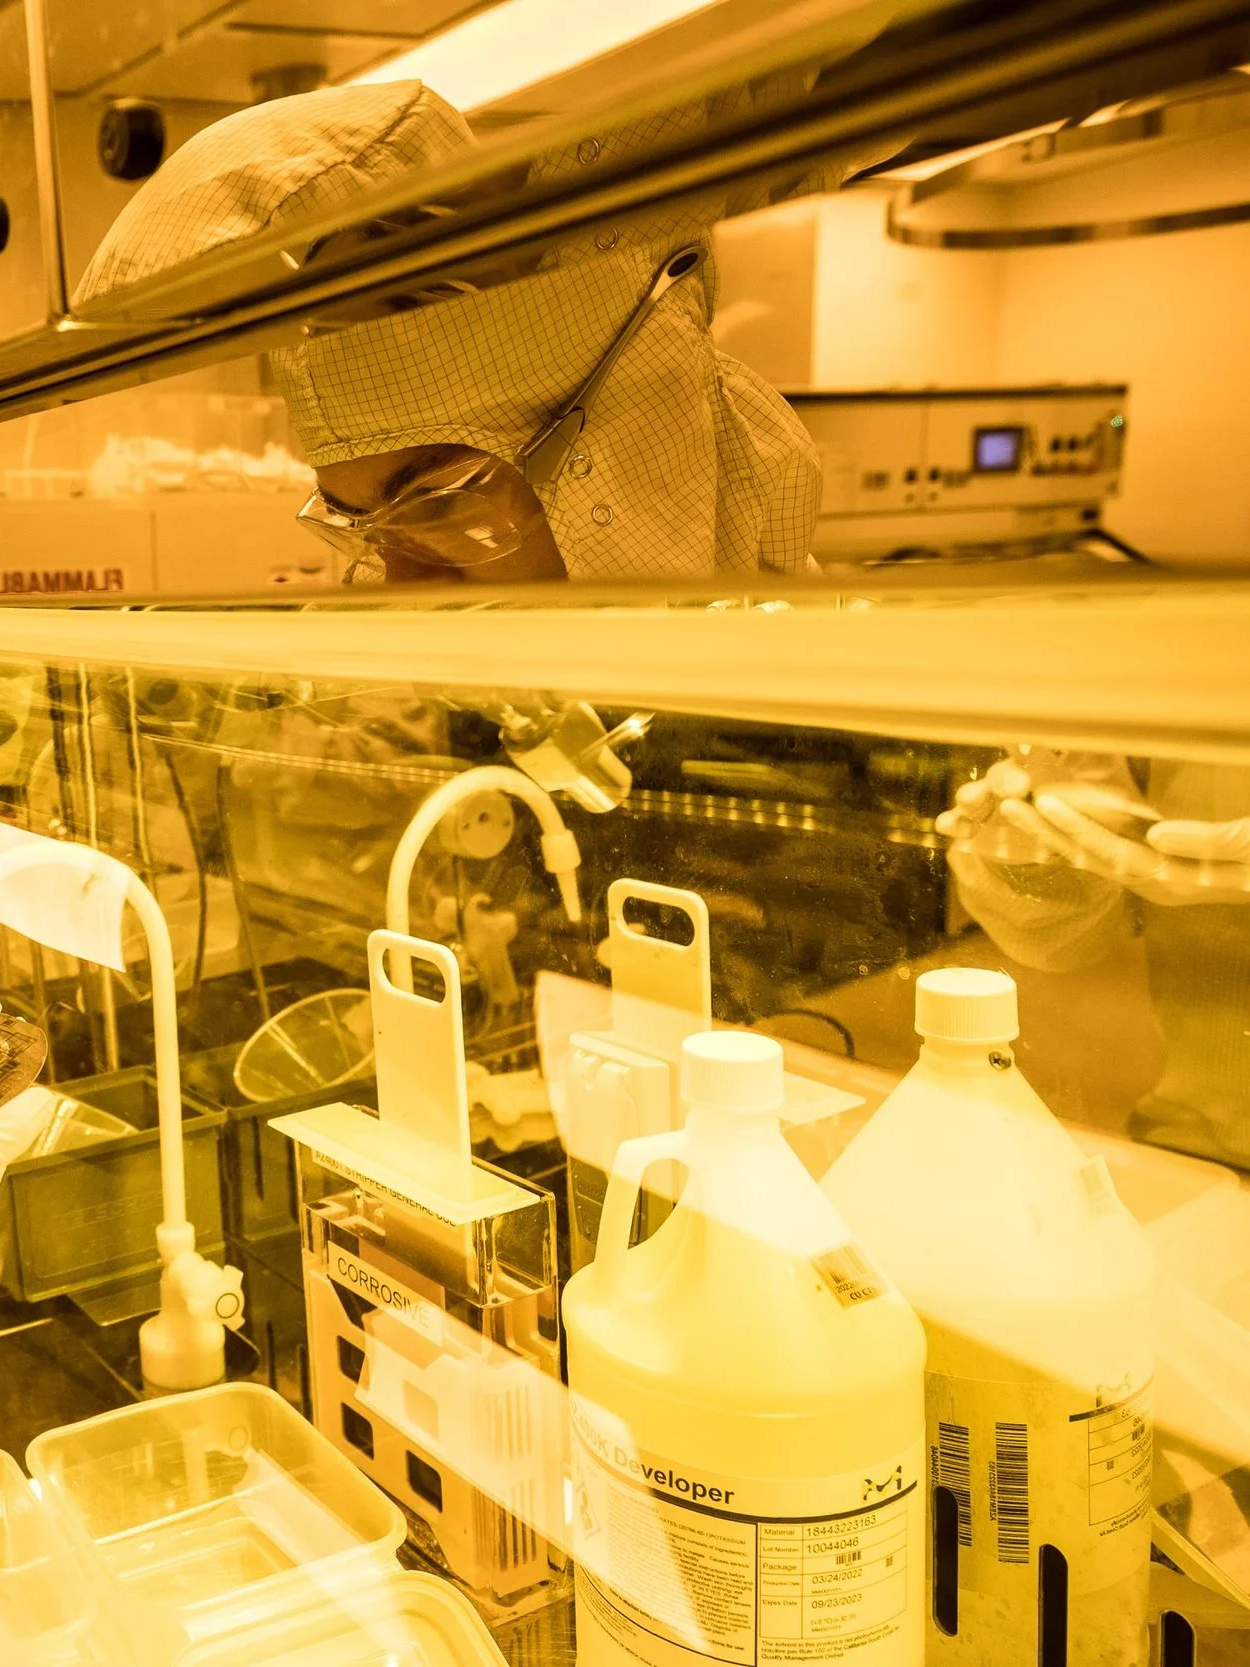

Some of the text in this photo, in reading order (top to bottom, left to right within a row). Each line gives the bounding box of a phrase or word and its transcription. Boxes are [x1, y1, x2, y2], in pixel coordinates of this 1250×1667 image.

[337, 1256, 430, 1329] CORROSIVE
[614, 1446, 736, 1505] Developer
[763, 1514, 877, 1538] Material 18443223163
[806, 1536, 860, 1555] 10044046
[762, 1563, 798, 1572] Package
[811, 1568, 864, 1585] 03/24/2022
[810, 1592, 863, 1609] 09/23/2023
